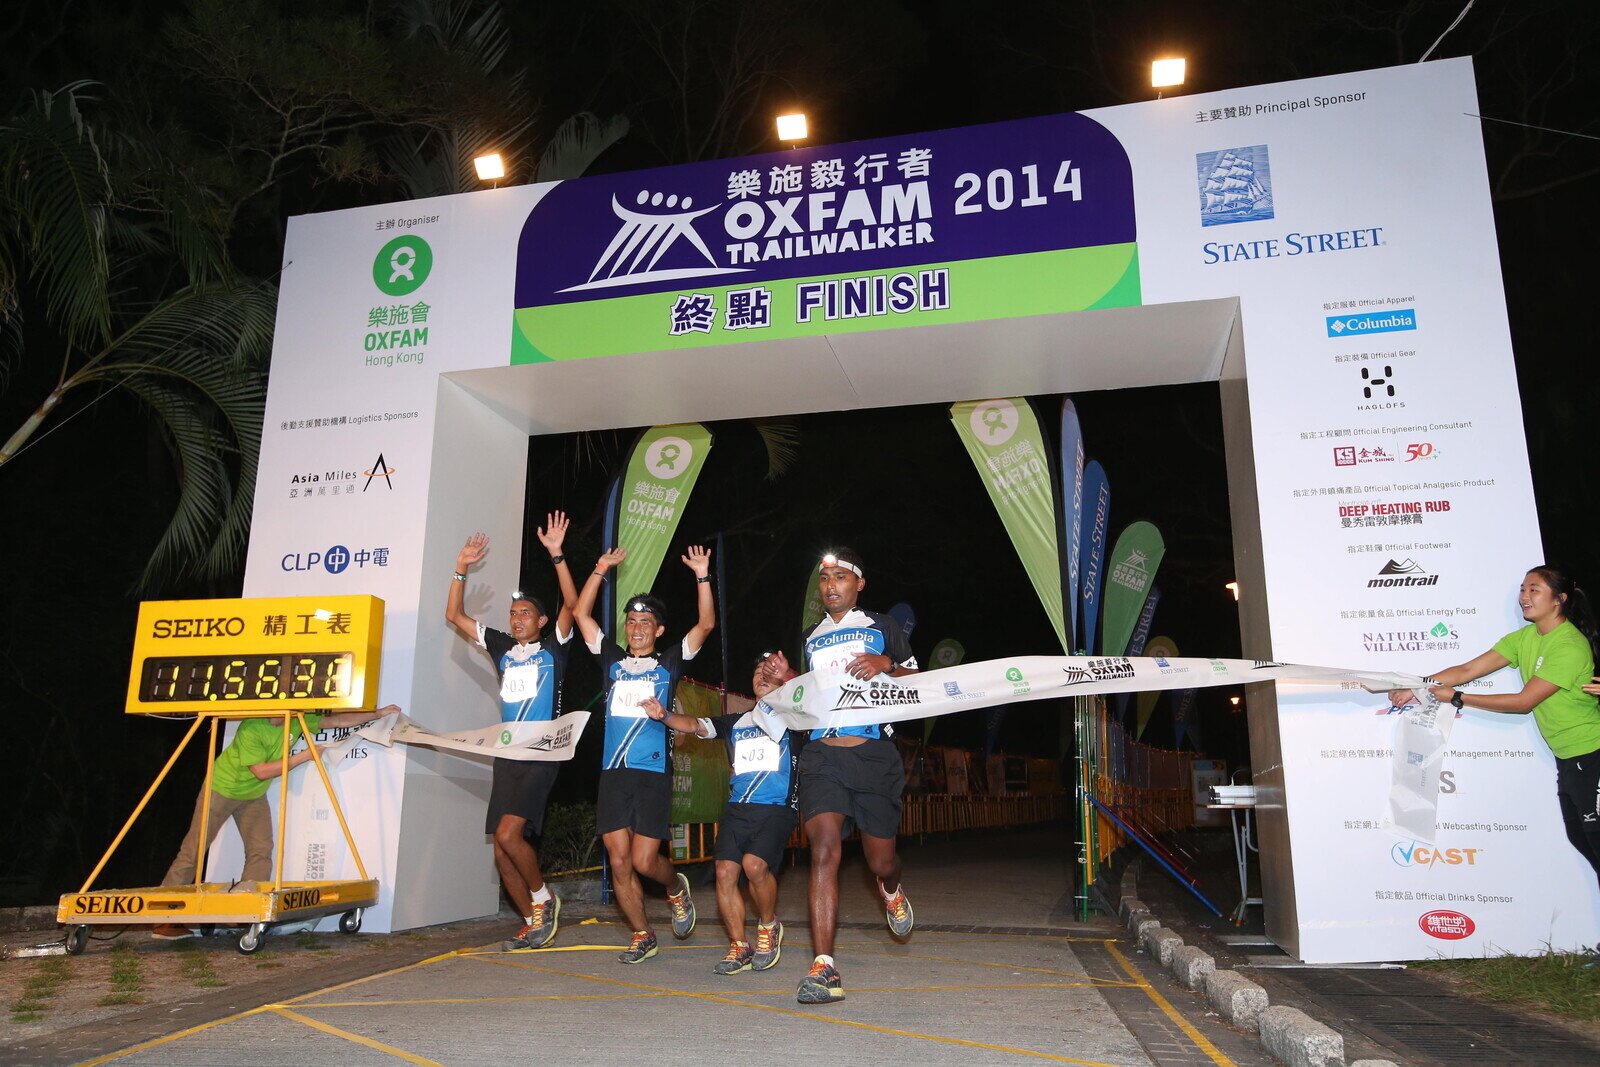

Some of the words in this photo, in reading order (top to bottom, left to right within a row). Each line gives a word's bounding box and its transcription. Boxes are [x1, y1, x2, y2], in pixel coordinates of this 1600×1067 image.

[1255, 98, 1310, 115] Principal
[1314, 92, 1366, 108] Sponsor
[726, 147, 933, 200] 樂施毅行者
[954, 160, 1082, 216] 2014
[723, 180, 933, 240] OXFAM
[376, 219, 395, 231] 主辦
[398, 215, 440, 229] Organiser
[726, 222, 934, 264] TRAILWALKER
[668, 285, 772, 336] 終點
[796, 268, 950, 323] FINISH
[1358, 299, 1385, 307] Official
[1386, 295, 1415, 305] Apparel
[367, 301, 431, 328] 樂施會
[1346, 315, 1413, 331] Columbia
[364, 327, 428, 351] OXFAM
[365, 354, 393, 367] Hong
[397, 352, 424, 364] Kong
[1370, 351, 1397, 360] Official
[348, 414, 382, 425] Logistics
[384, 411, 419, 422] Sponsors
[1353, 427, 1379, 436] Official
[1381, 424, 1428, 436] Engineering
[1429, 421, 1472, 431] Consultant
[1404, 442, 1433, 463] 50
[291, 474, 320, 484] Asia
[325, 470, 357, 482] Miles
[1364, 484, 1391, 493] Official
[1393, 482, 1421, 493] Topical
[1423, 479, 1462, 491] Analgesic
[1463, 477, 1495, 487] Product
[633, 480, 681, 504] 樂施會
[628, 499, 675, 521] OXFAM
[1339, 505, 1369, 517] DEEP
[1372, 502, 1422, 515] HEATING
[1425, 500, 1451, 512] RUB
[626, 515, 647, 529] Hong
[647, 519, 667, 534] Kong
[1084, 548, 1100, 605] STATE
[1092, 482, 1109, 547] STREET
[1385, 543, 1412, 551] Official
[1414, 542, 1451, 550] Footwear
[281, 552, 321, 572] CLP
[354, 548, 390, 568] 中電
[1112, 569, 1148, 588] OXFAM
[1367, 575, 1439, 588] montrail
[1396, 609, 1424, 617] Official
[1426, 608, 1454, 617] Energy
[1456, 607, 1476, 615] Food
[152, 616, 245, 639] SEIKO
[262, 612, 351, 636] 精工表
[815, 630, 874, 648] Columbia
[1363, 642, 1425, 652] VILLAGE
[1091, 663, 1134, 676] OXFAM
[1094, 671, 1136, 681] TRAILWALKER
[1472, 680, 1494, 689] Shop
[870, 689, 919, 700] OXFAM
[1450, 750, 1502, 759] Management
[1504, 750, 1534, 758] Partner
[672, 775, 693, 793] XFAM
[1442, 823, 1491, 832] Webcasting
[1493, 823, 1527, 832] Sponsor
[74, 896, 144, 915] SEIKO
[283, 889, 320, 911] SEIKO
[1375, 890, 1414, 901] 指定飲品
[1415, 892, 1446, 901] Official
[1448, 893, 1475, 902] Drinks
[1477, 893, 1513, 904] Sponsor
[1428, 925, 1469, 936] vitasoy
